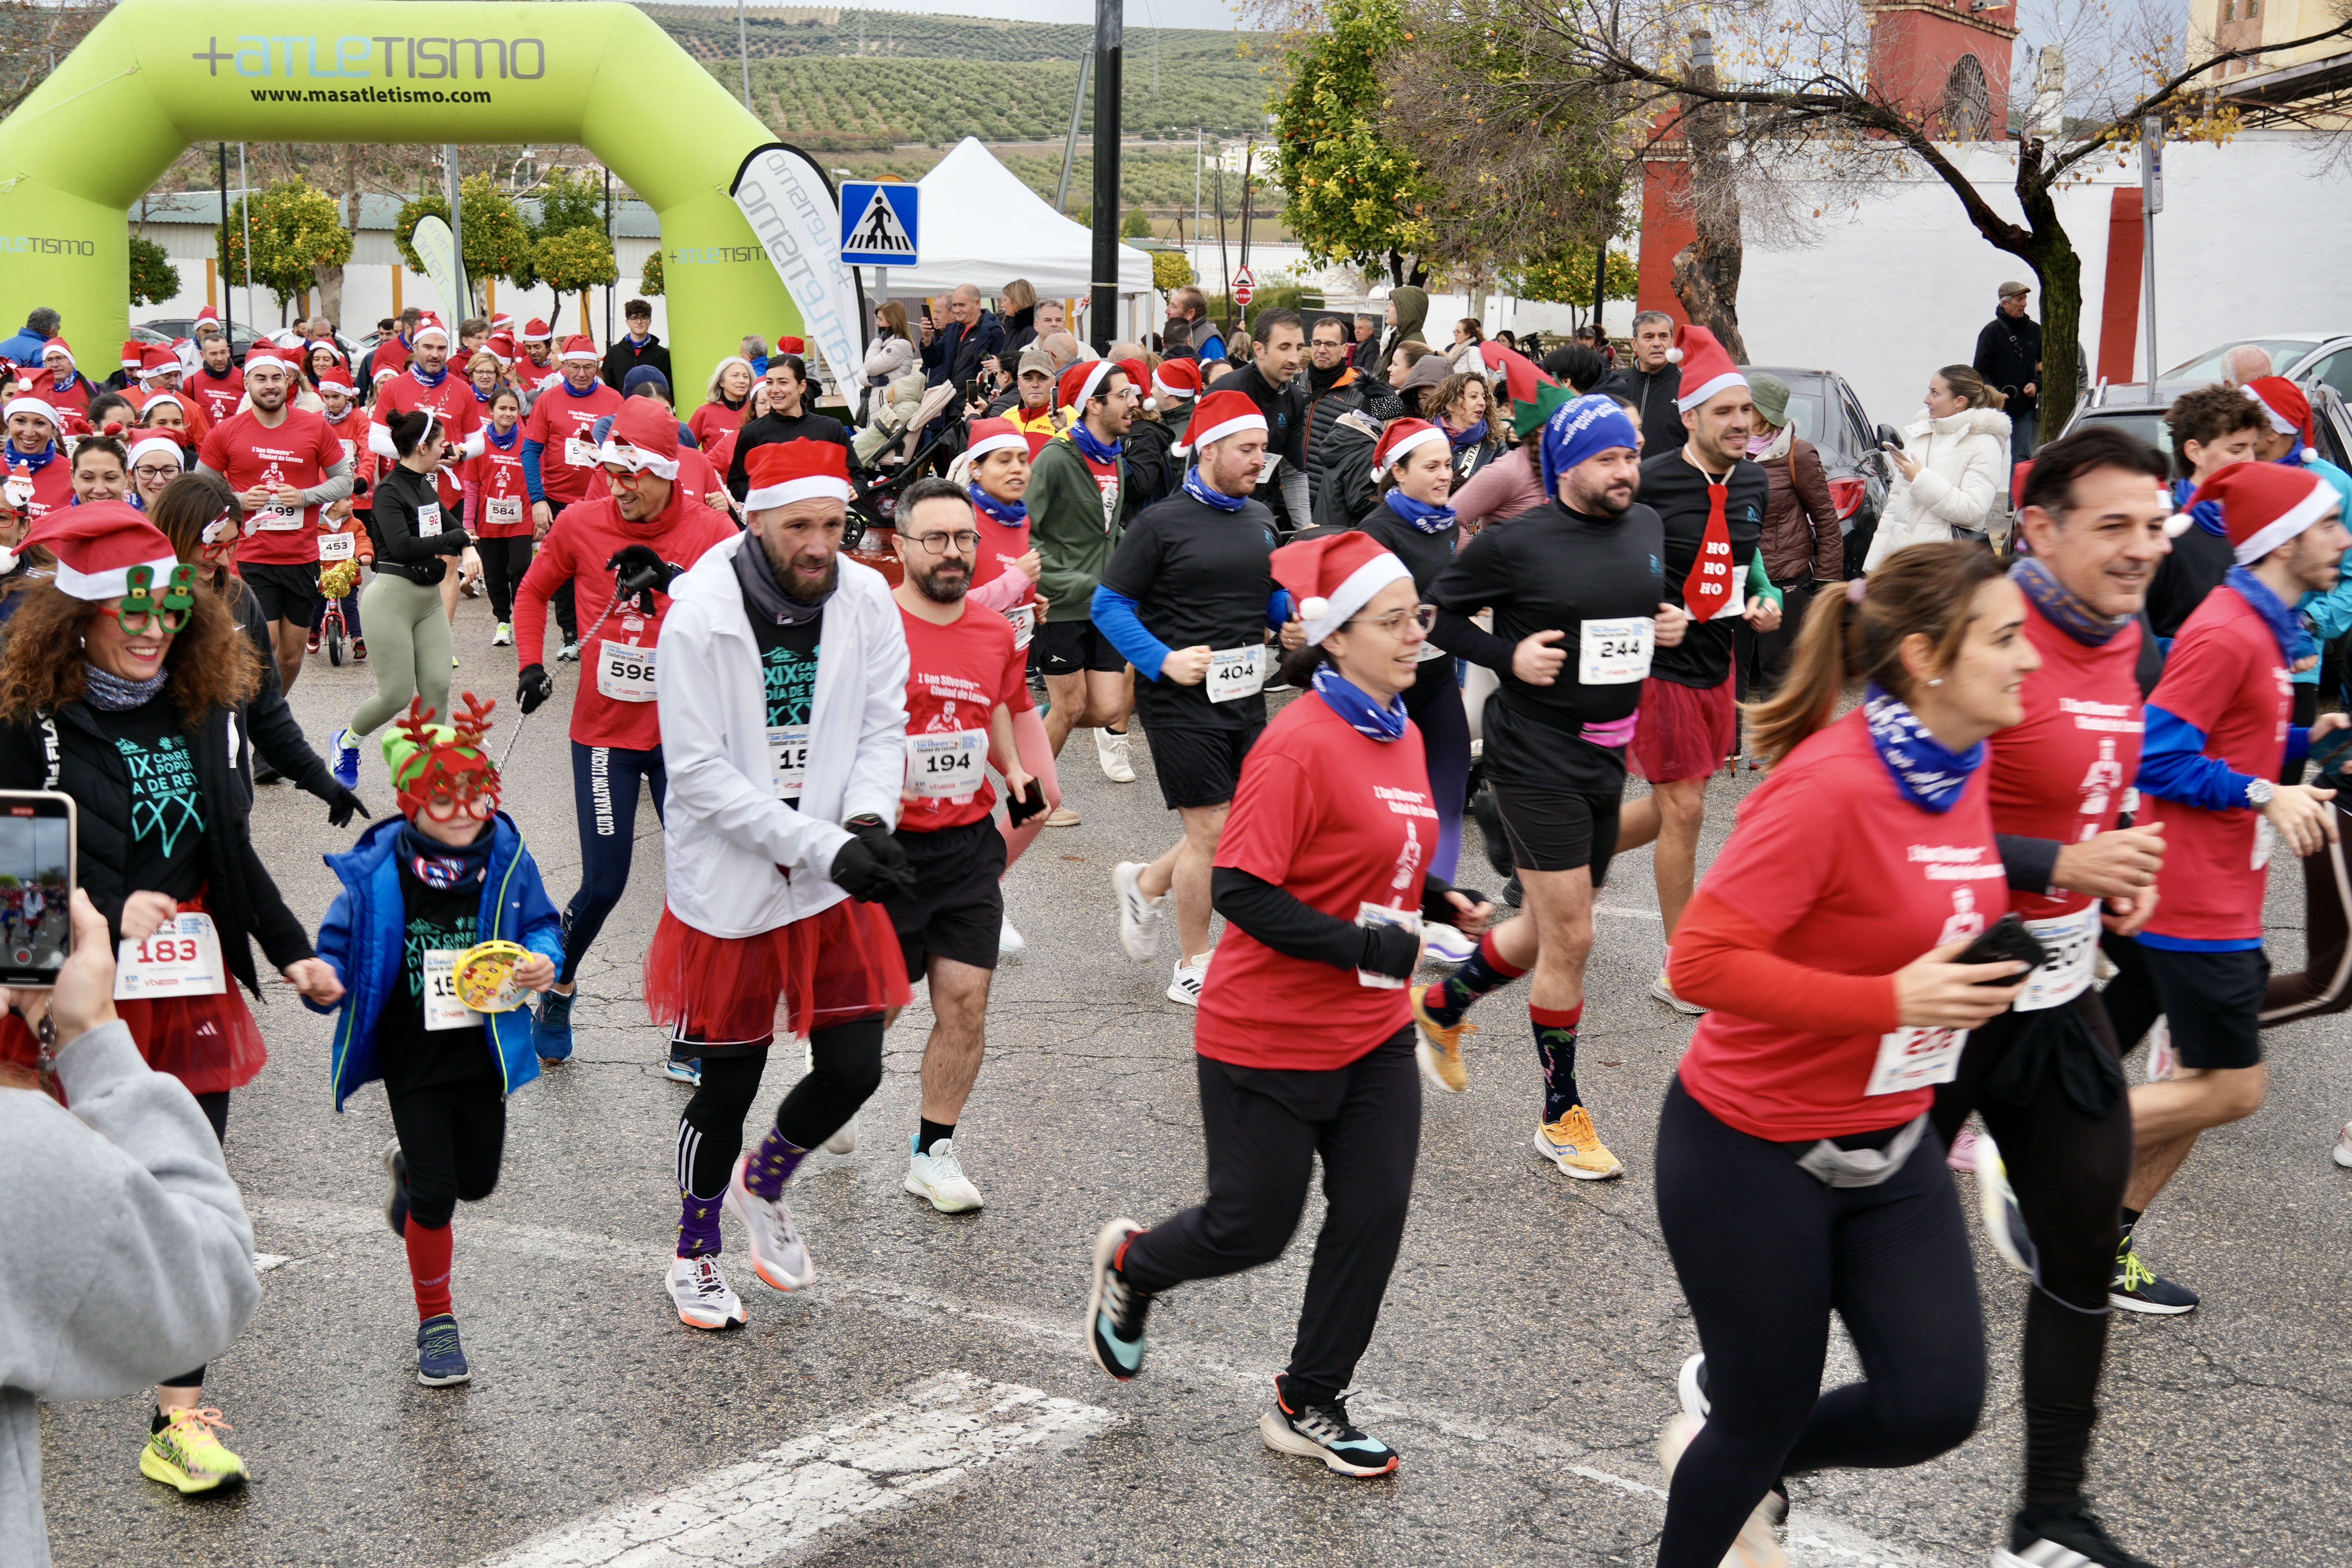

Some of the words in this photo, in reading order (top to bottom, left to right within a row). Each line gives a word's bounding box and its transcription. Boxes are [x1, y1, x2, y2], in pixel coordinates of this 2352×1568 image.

[251, 86, 491, 103] www.masatletismo.com
[267, 507, 295, 516] 199
[493, 507, 515, 515] 584
[326, 542, 347, 550] 453
[1706, 542, 1729, 555] HO
[1702, 562, 1726, 575] HO
[1699, 582, 1723, 595] HO
[1601, 640, 1640, 657] 244
[764, 664, 797, 684] XIX
[1220, 664, 1253, 680] 404
[765, 685, 788, 701] DÍA
[788, 684, 805, 699] DE
[591, 747, 610, 776] LUCENA
[927, 752, 970, 773] 194
[147, 777, 170, 792] DE
[591, 776, 613, 814] MARATON
[596, 815, 615, 835] CLUB
[137, 939, 196, 963] 183
[427, 1325, 456, 1335] SKECHERS
